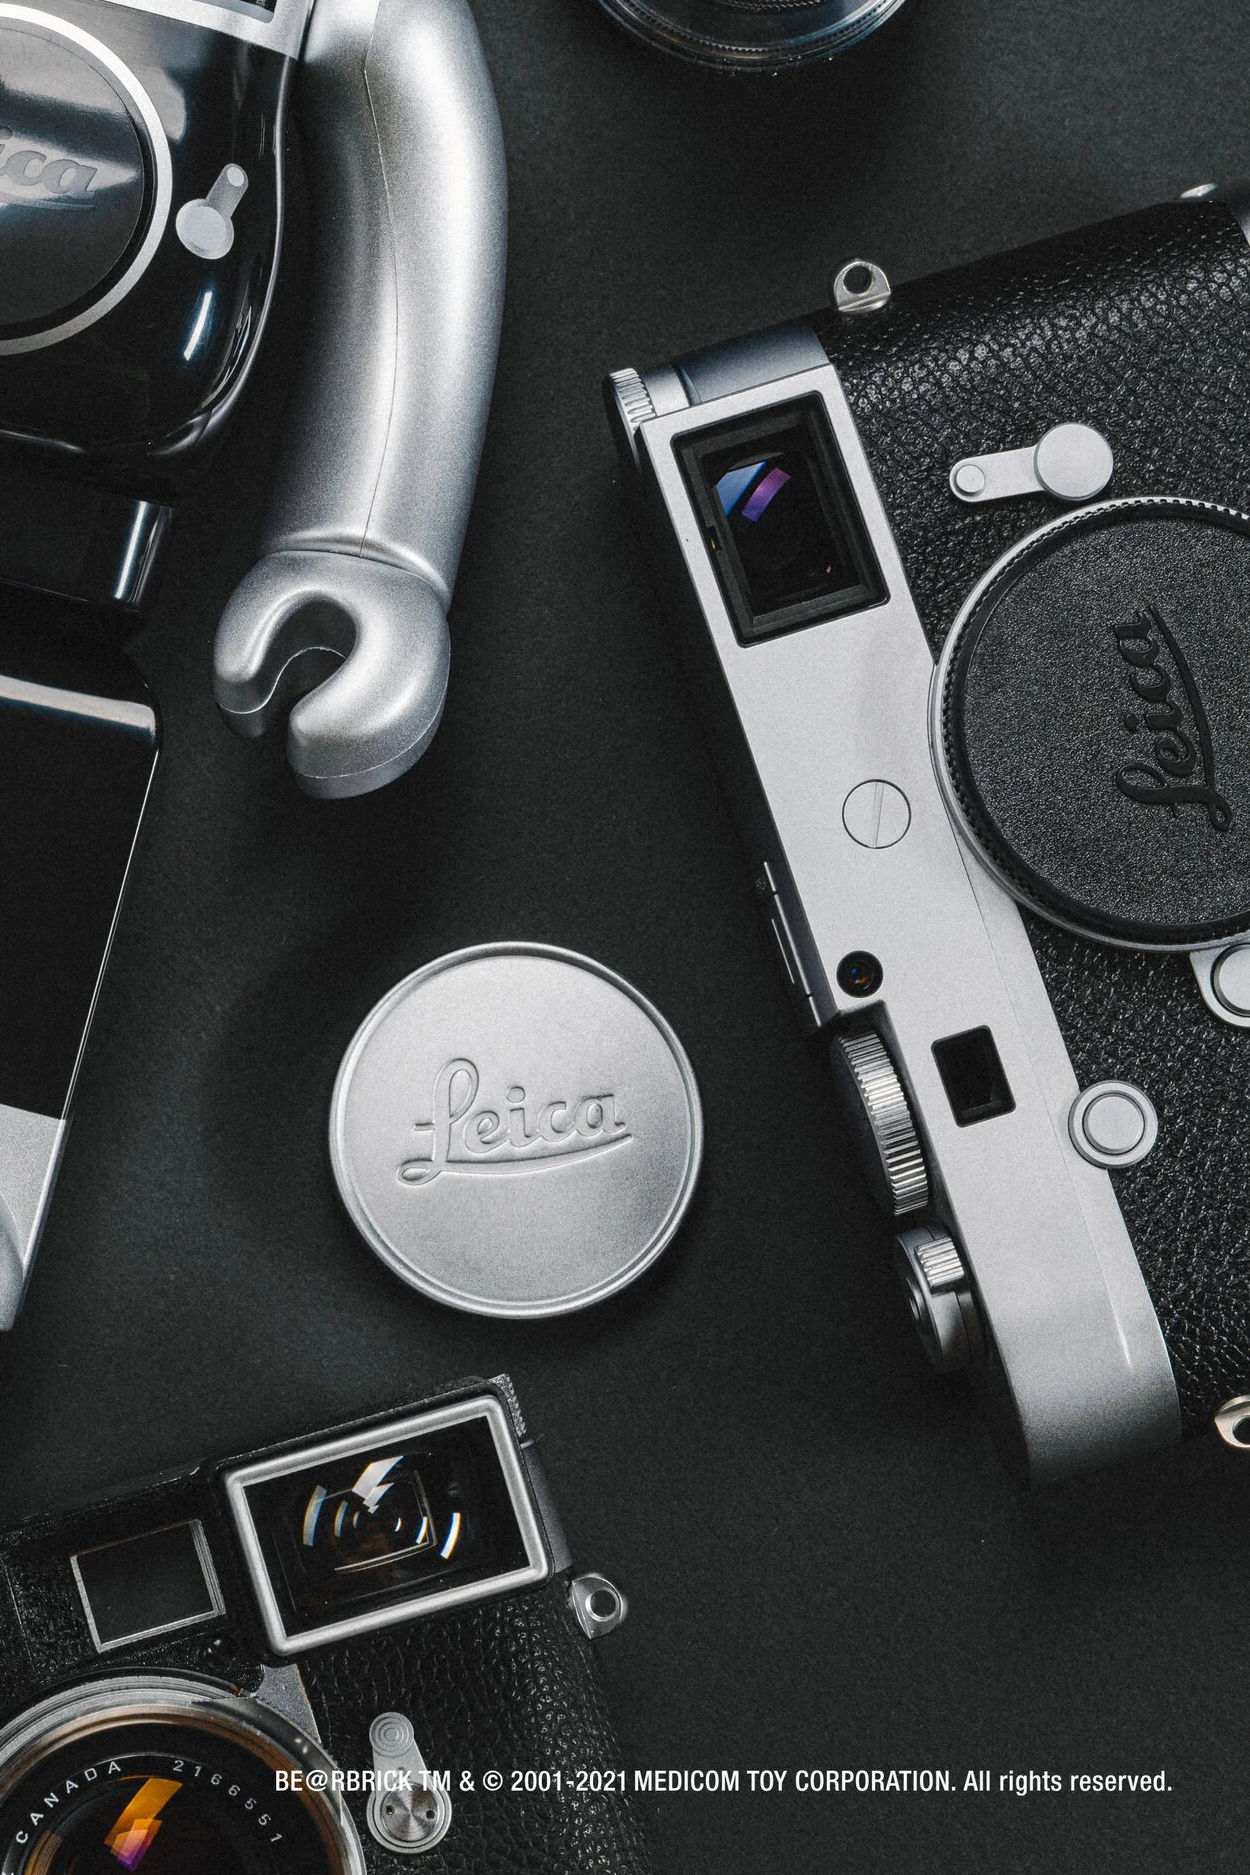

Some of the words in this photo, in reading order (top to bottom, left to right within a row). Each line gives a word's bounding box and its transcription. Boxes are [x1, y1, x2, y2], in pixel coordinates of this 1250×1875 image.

[1114, 604, 1234, 834] Leica
[396, 1056, 634, 1187] Leica
[14, 1760, 122, 1845] CANADA
[171, 1758, 285, 1844] 2166551
